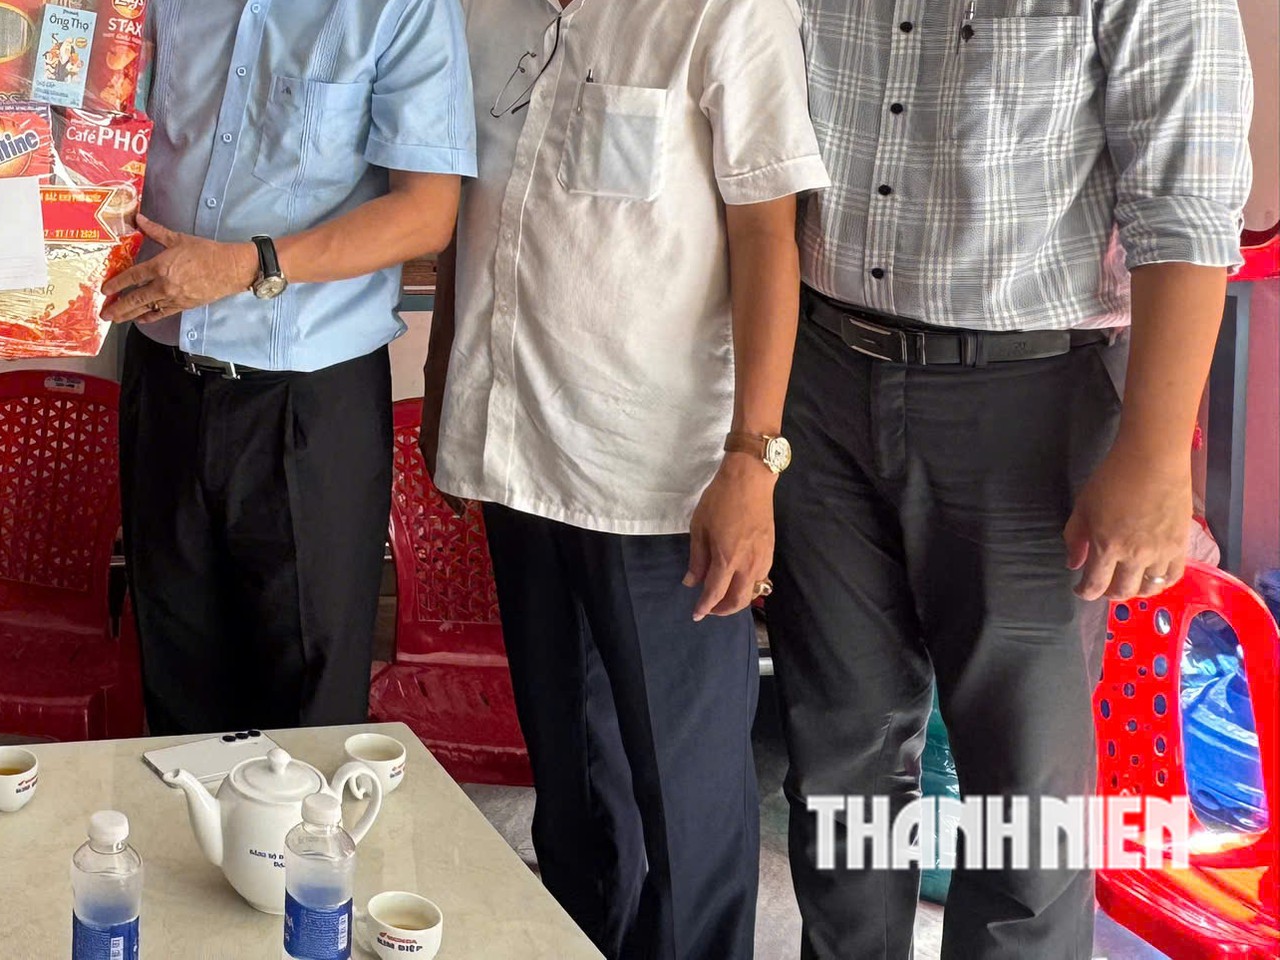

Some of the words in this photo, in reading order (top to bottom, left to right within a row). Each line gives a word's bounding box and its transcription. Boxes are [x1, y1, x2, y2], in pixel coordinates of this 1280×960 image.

[108, 18, 144, 36] STAX
[66, 125, 97, 145] Café
[96, 125, 152, 156] PHỐ
